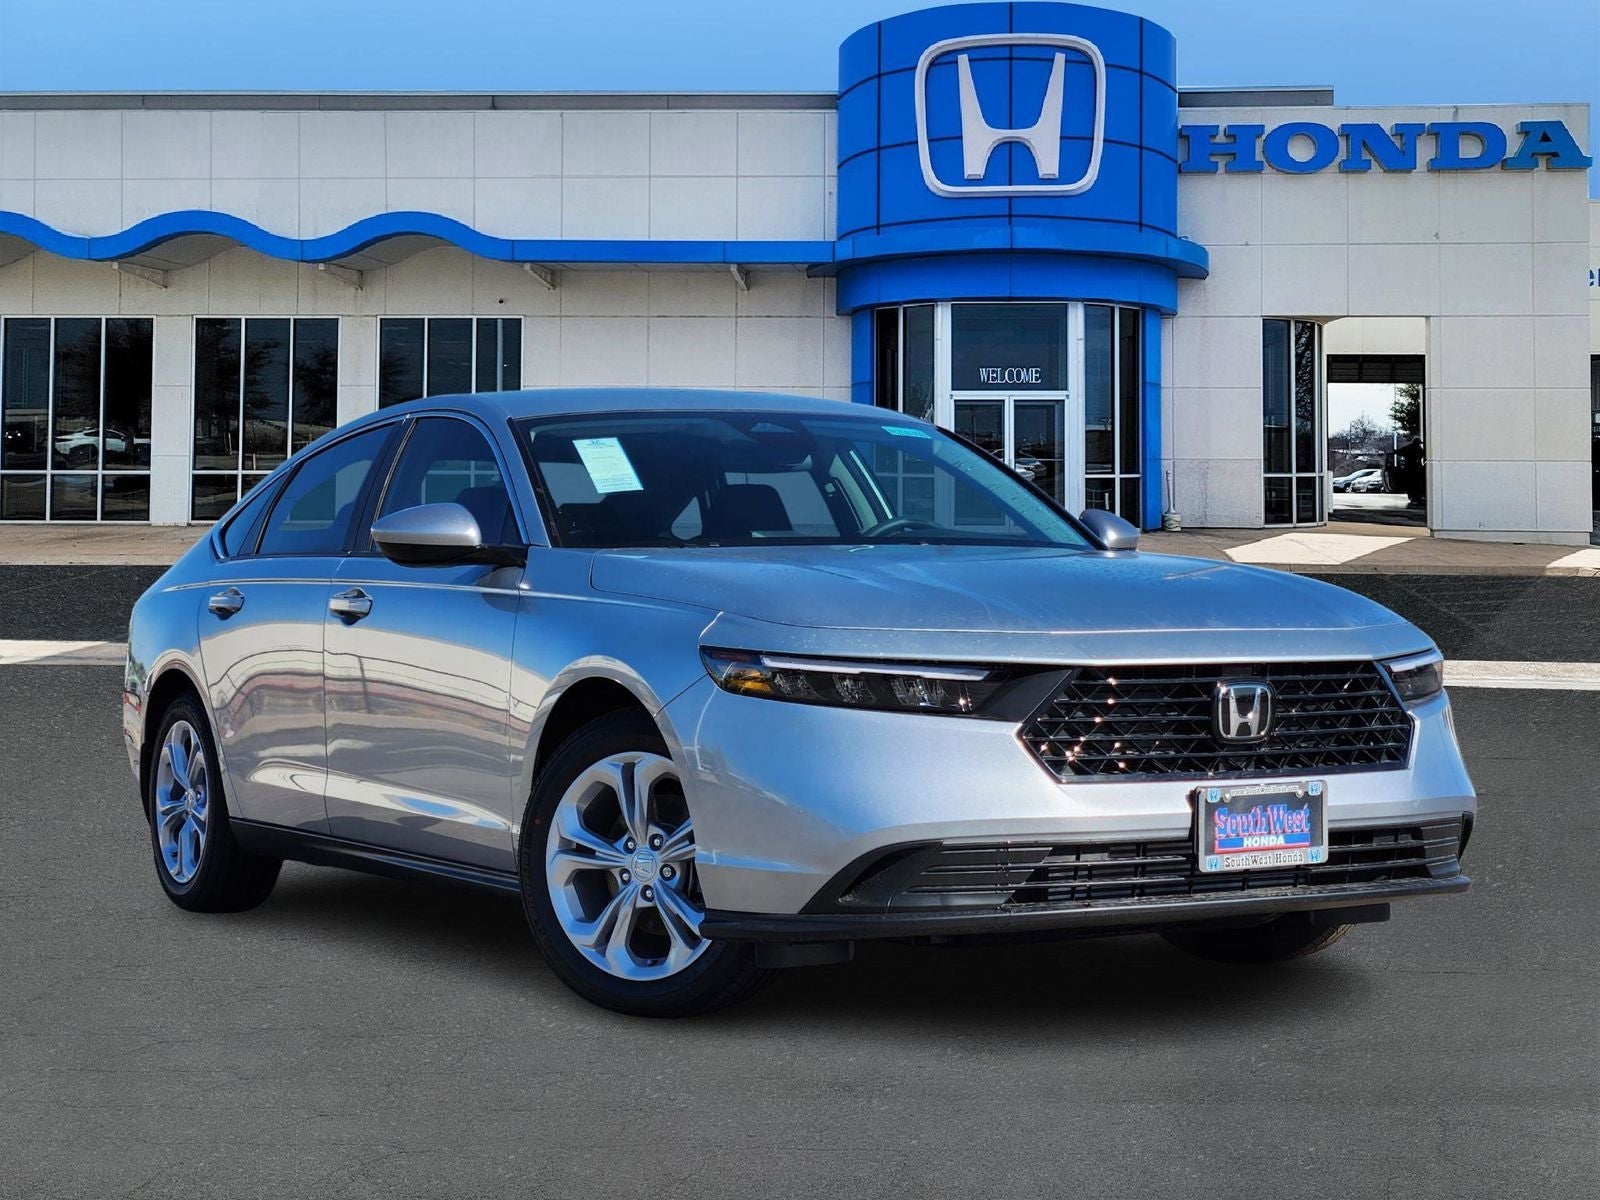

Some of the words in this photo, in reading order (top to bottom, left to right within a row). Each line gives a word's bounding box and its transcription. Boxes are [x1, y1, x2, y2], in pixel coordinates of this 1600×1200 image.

[1178, 121, 1593, 174] HONDA
[979, 367, 1041, 383] WELCOME
[1243, 835, 1285, 848] HONDA
[1224, 854, 1272, 868] SouthWest
[1275, 851, 1303, 864] Honda
